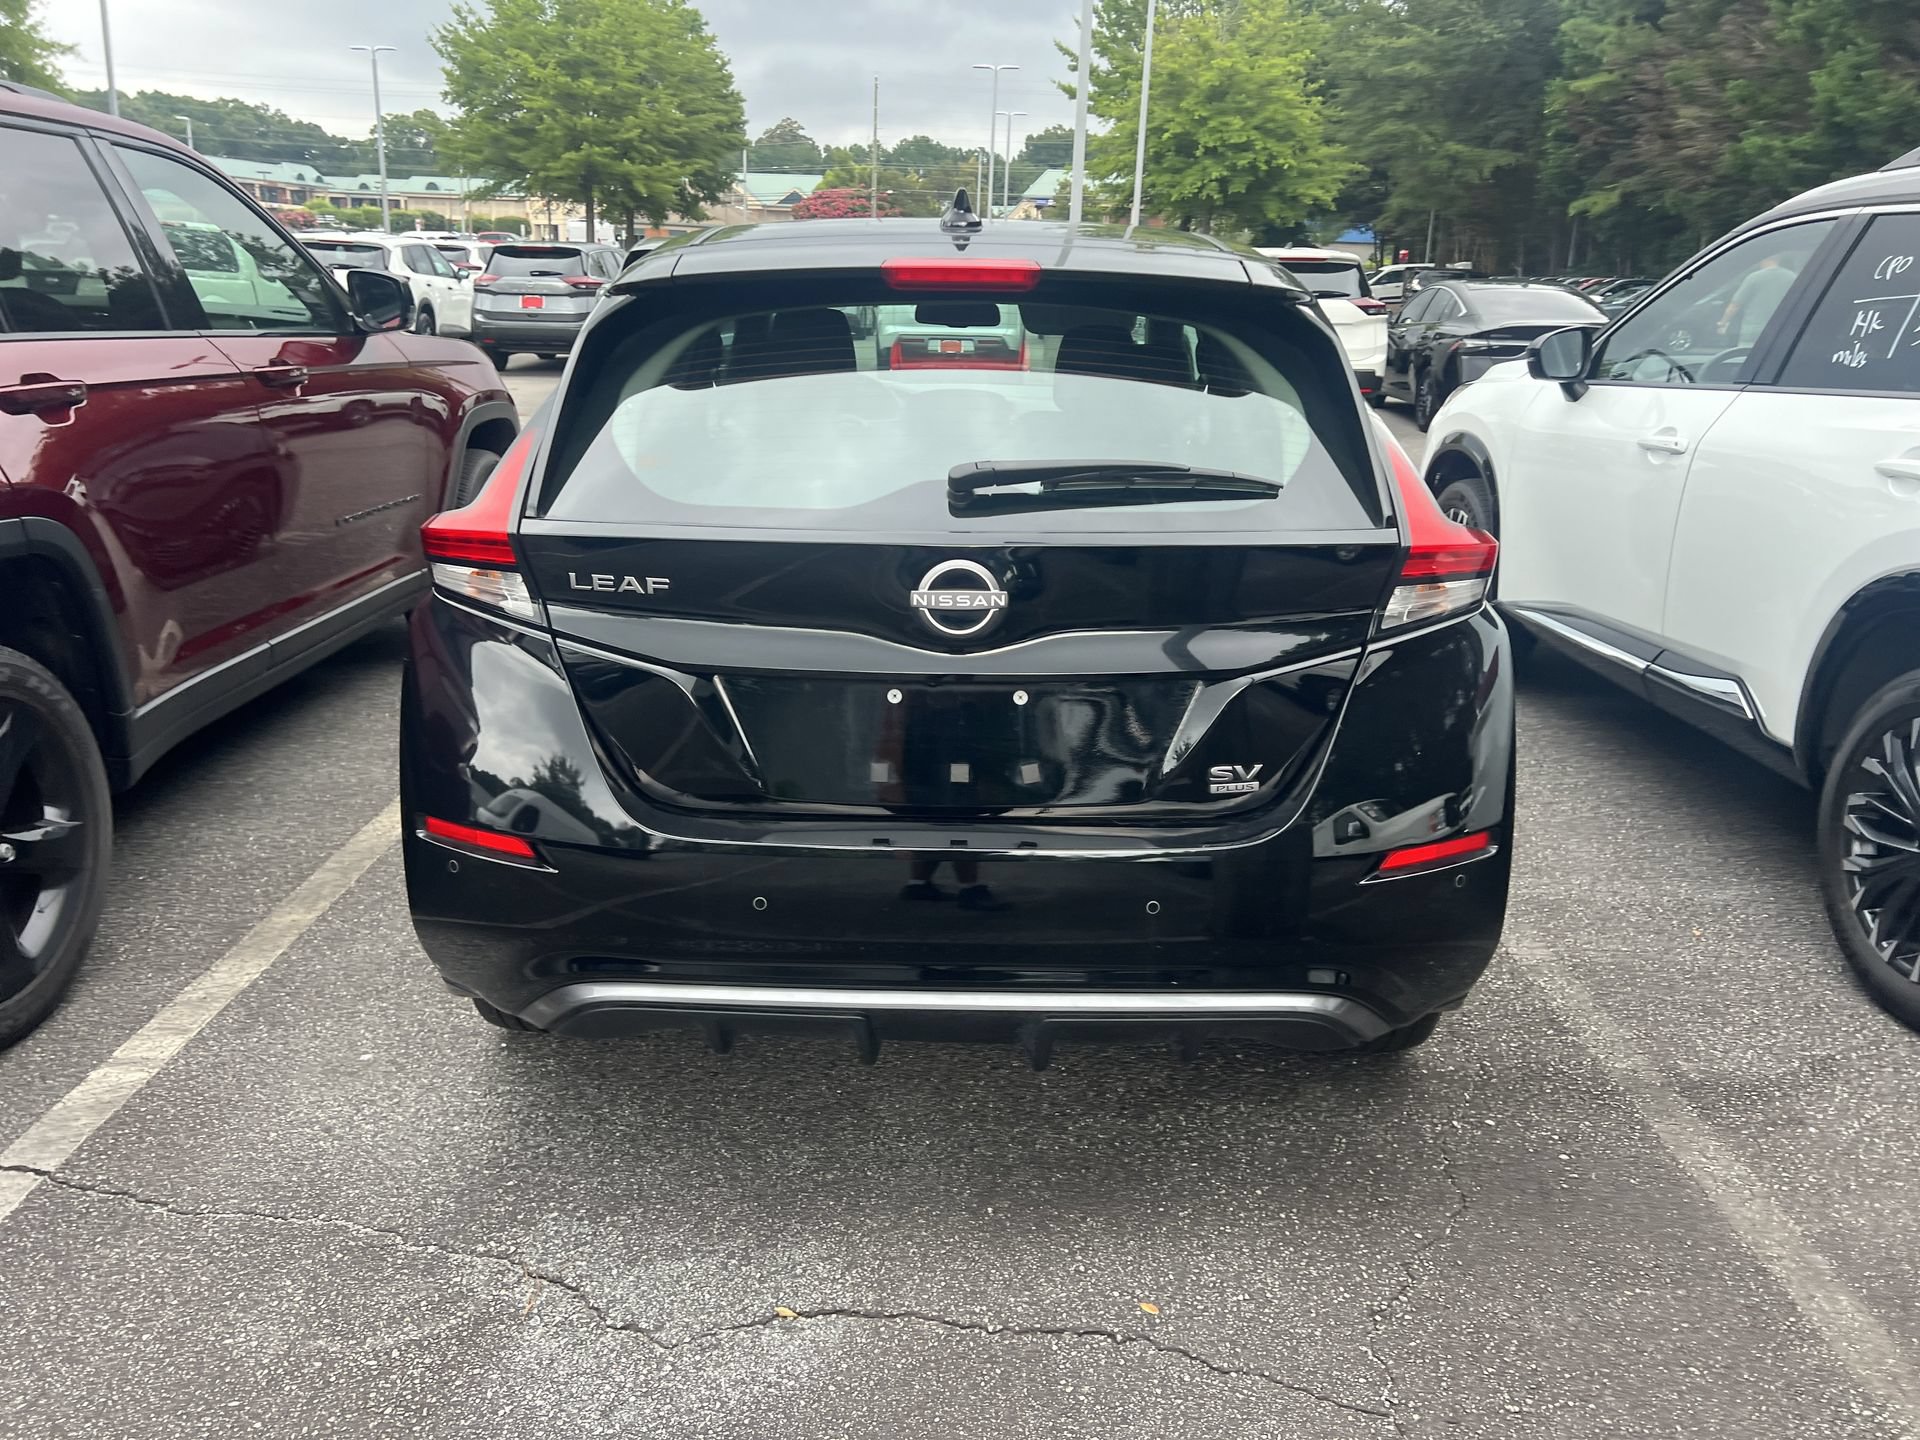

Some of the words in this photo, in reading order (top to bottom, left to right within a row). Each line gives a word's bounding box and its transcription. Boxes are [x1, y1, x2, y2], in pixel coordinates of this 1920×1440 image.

[1874, 255, 1914, 280] CPO
[1831, 341, 1868, 368] miles
[568, 572, 670, 595] LEAF
[912, 593, 1006, 607] NISSAN
[1209, 764, 1263, 782] SV
[1216, 783, 1255, 792] PLUS
